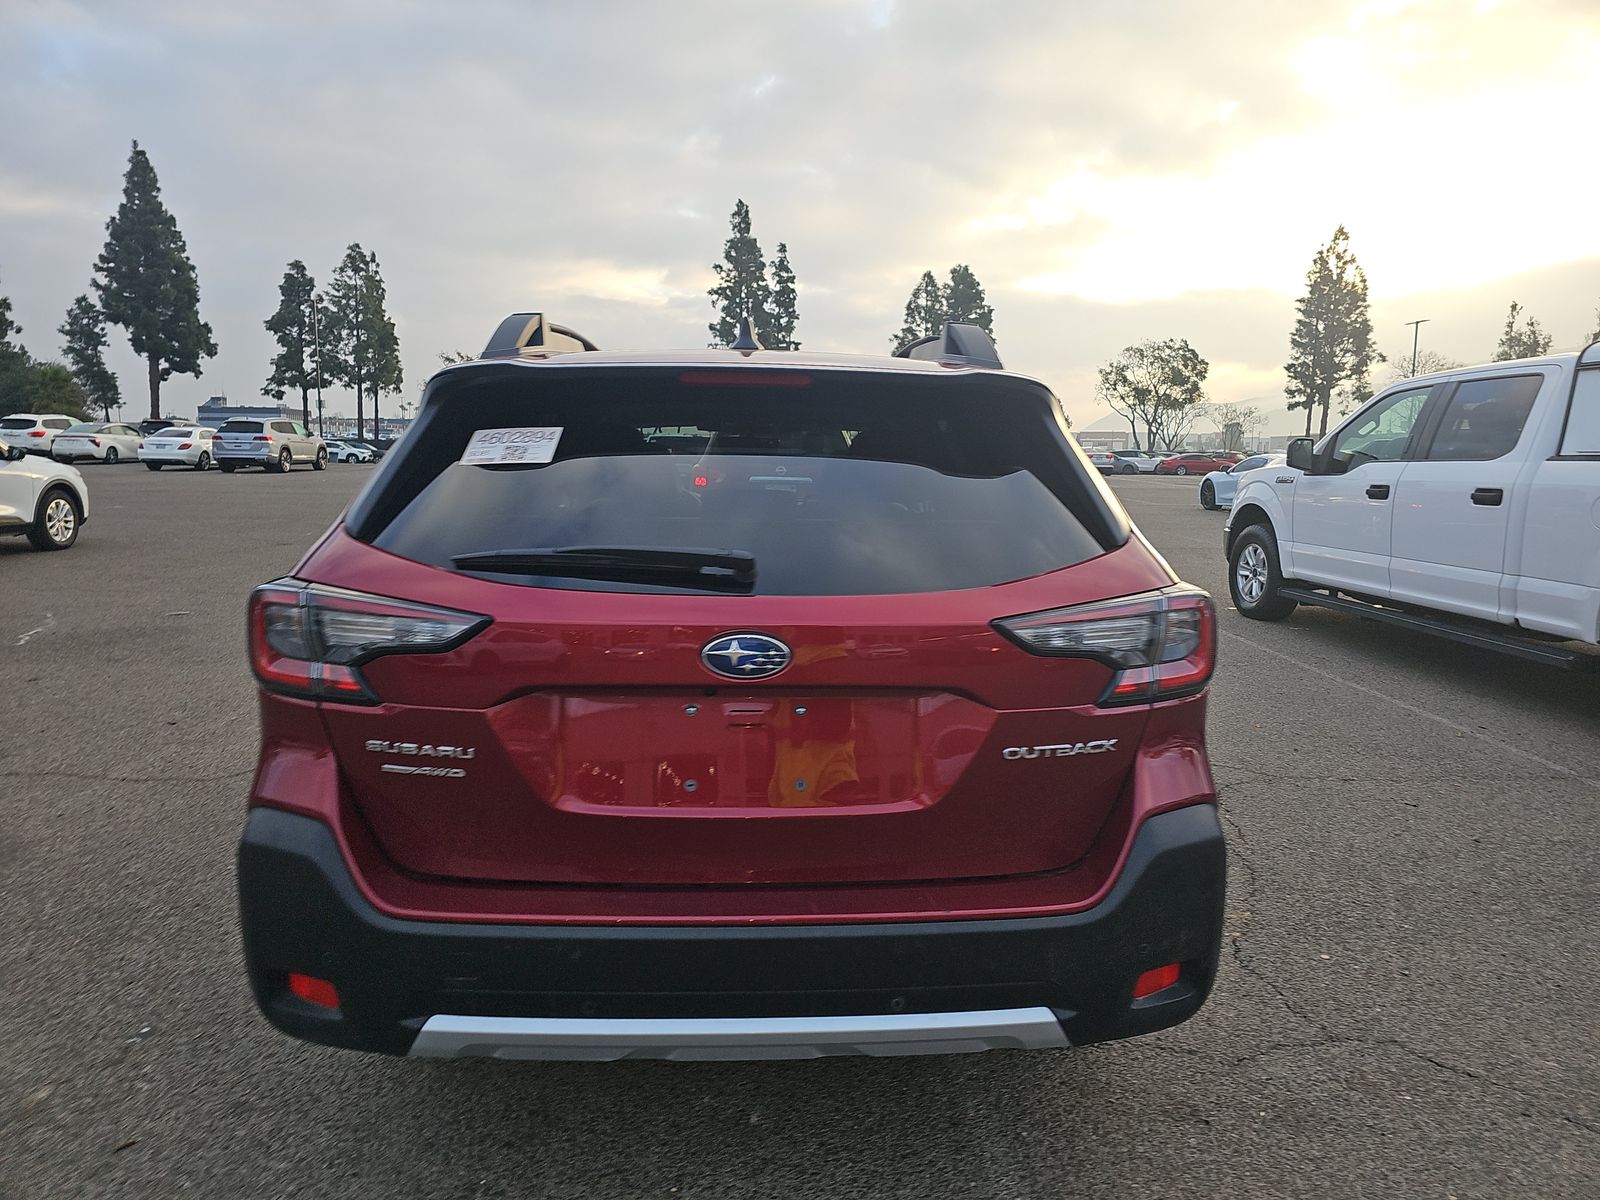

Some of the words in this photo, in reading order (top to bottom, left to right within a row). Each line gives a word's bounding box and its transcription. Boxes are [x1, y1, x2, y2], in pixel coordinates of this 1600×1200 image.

[365, 739, 476, 759] SUBARU
[1002, 739, 1119, 760] OUTBACK
[410, 766, 467, 778] AWD
